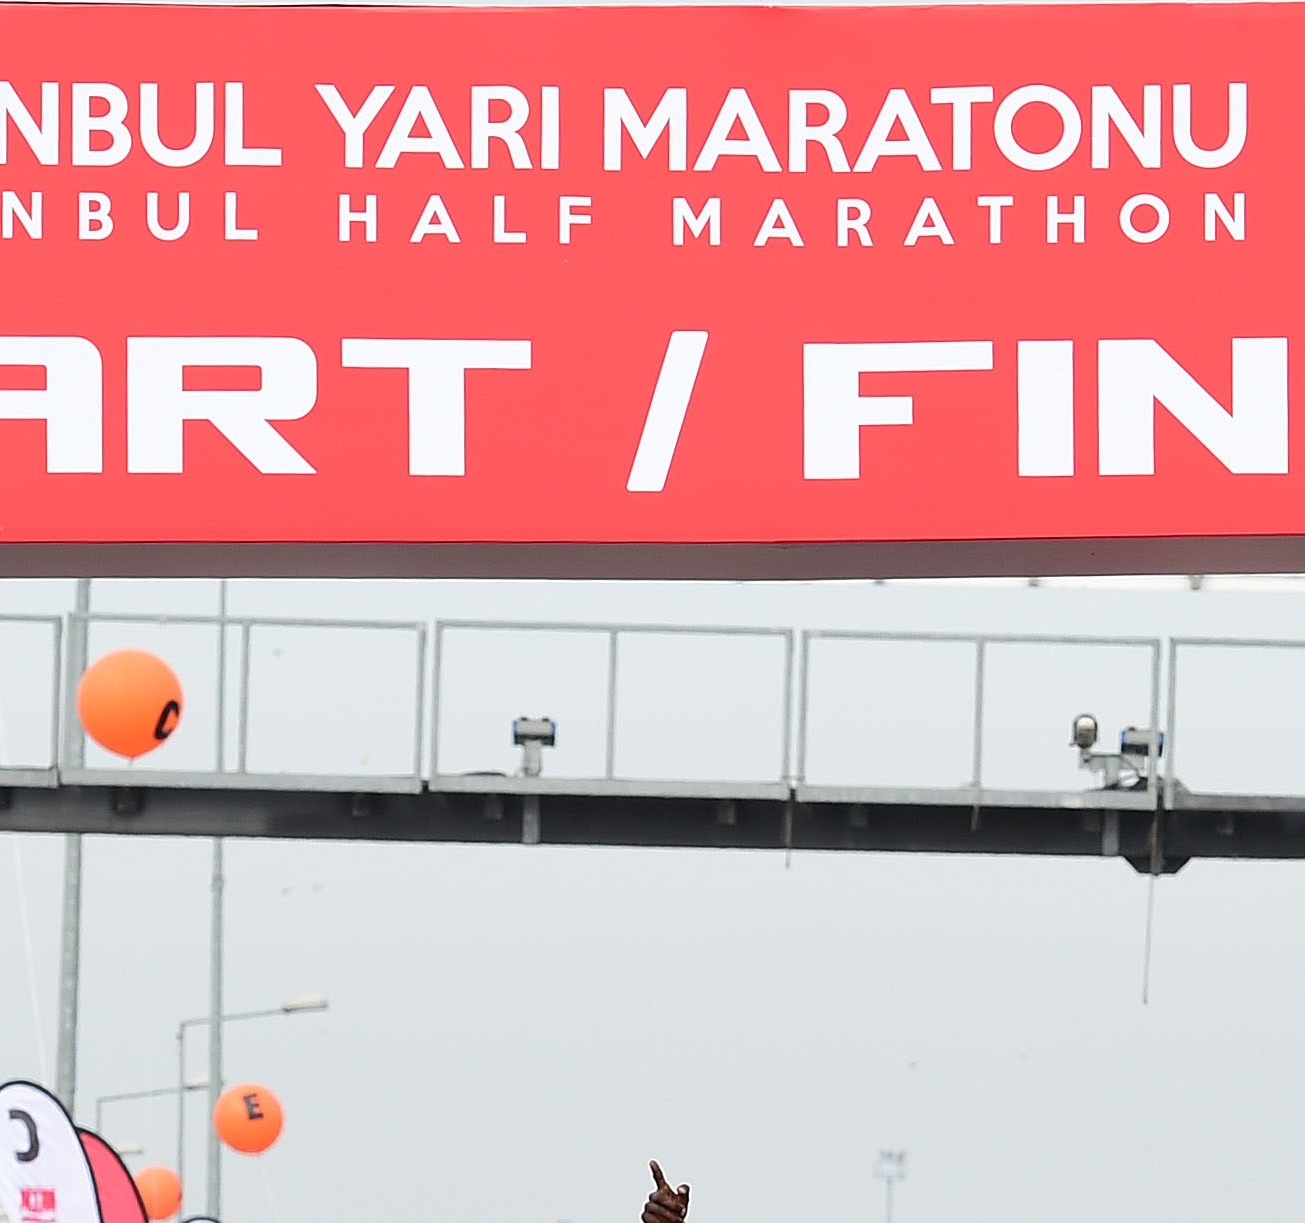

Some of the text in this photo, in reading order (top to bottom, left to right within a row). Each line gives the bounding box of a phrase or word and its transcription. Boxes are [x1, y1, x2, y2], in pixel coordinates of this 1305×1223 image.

[315, 84, 561, 171] YARI
[602, 82, 1247, 172] MARATONU
[337, 193, 593, 246] HALF
[672, 192, 1247, 247] MARATHON
[625, 330, 709, 494] /
[154, 699, 180, 742] C
[243, 1092, 265, 1121] E
